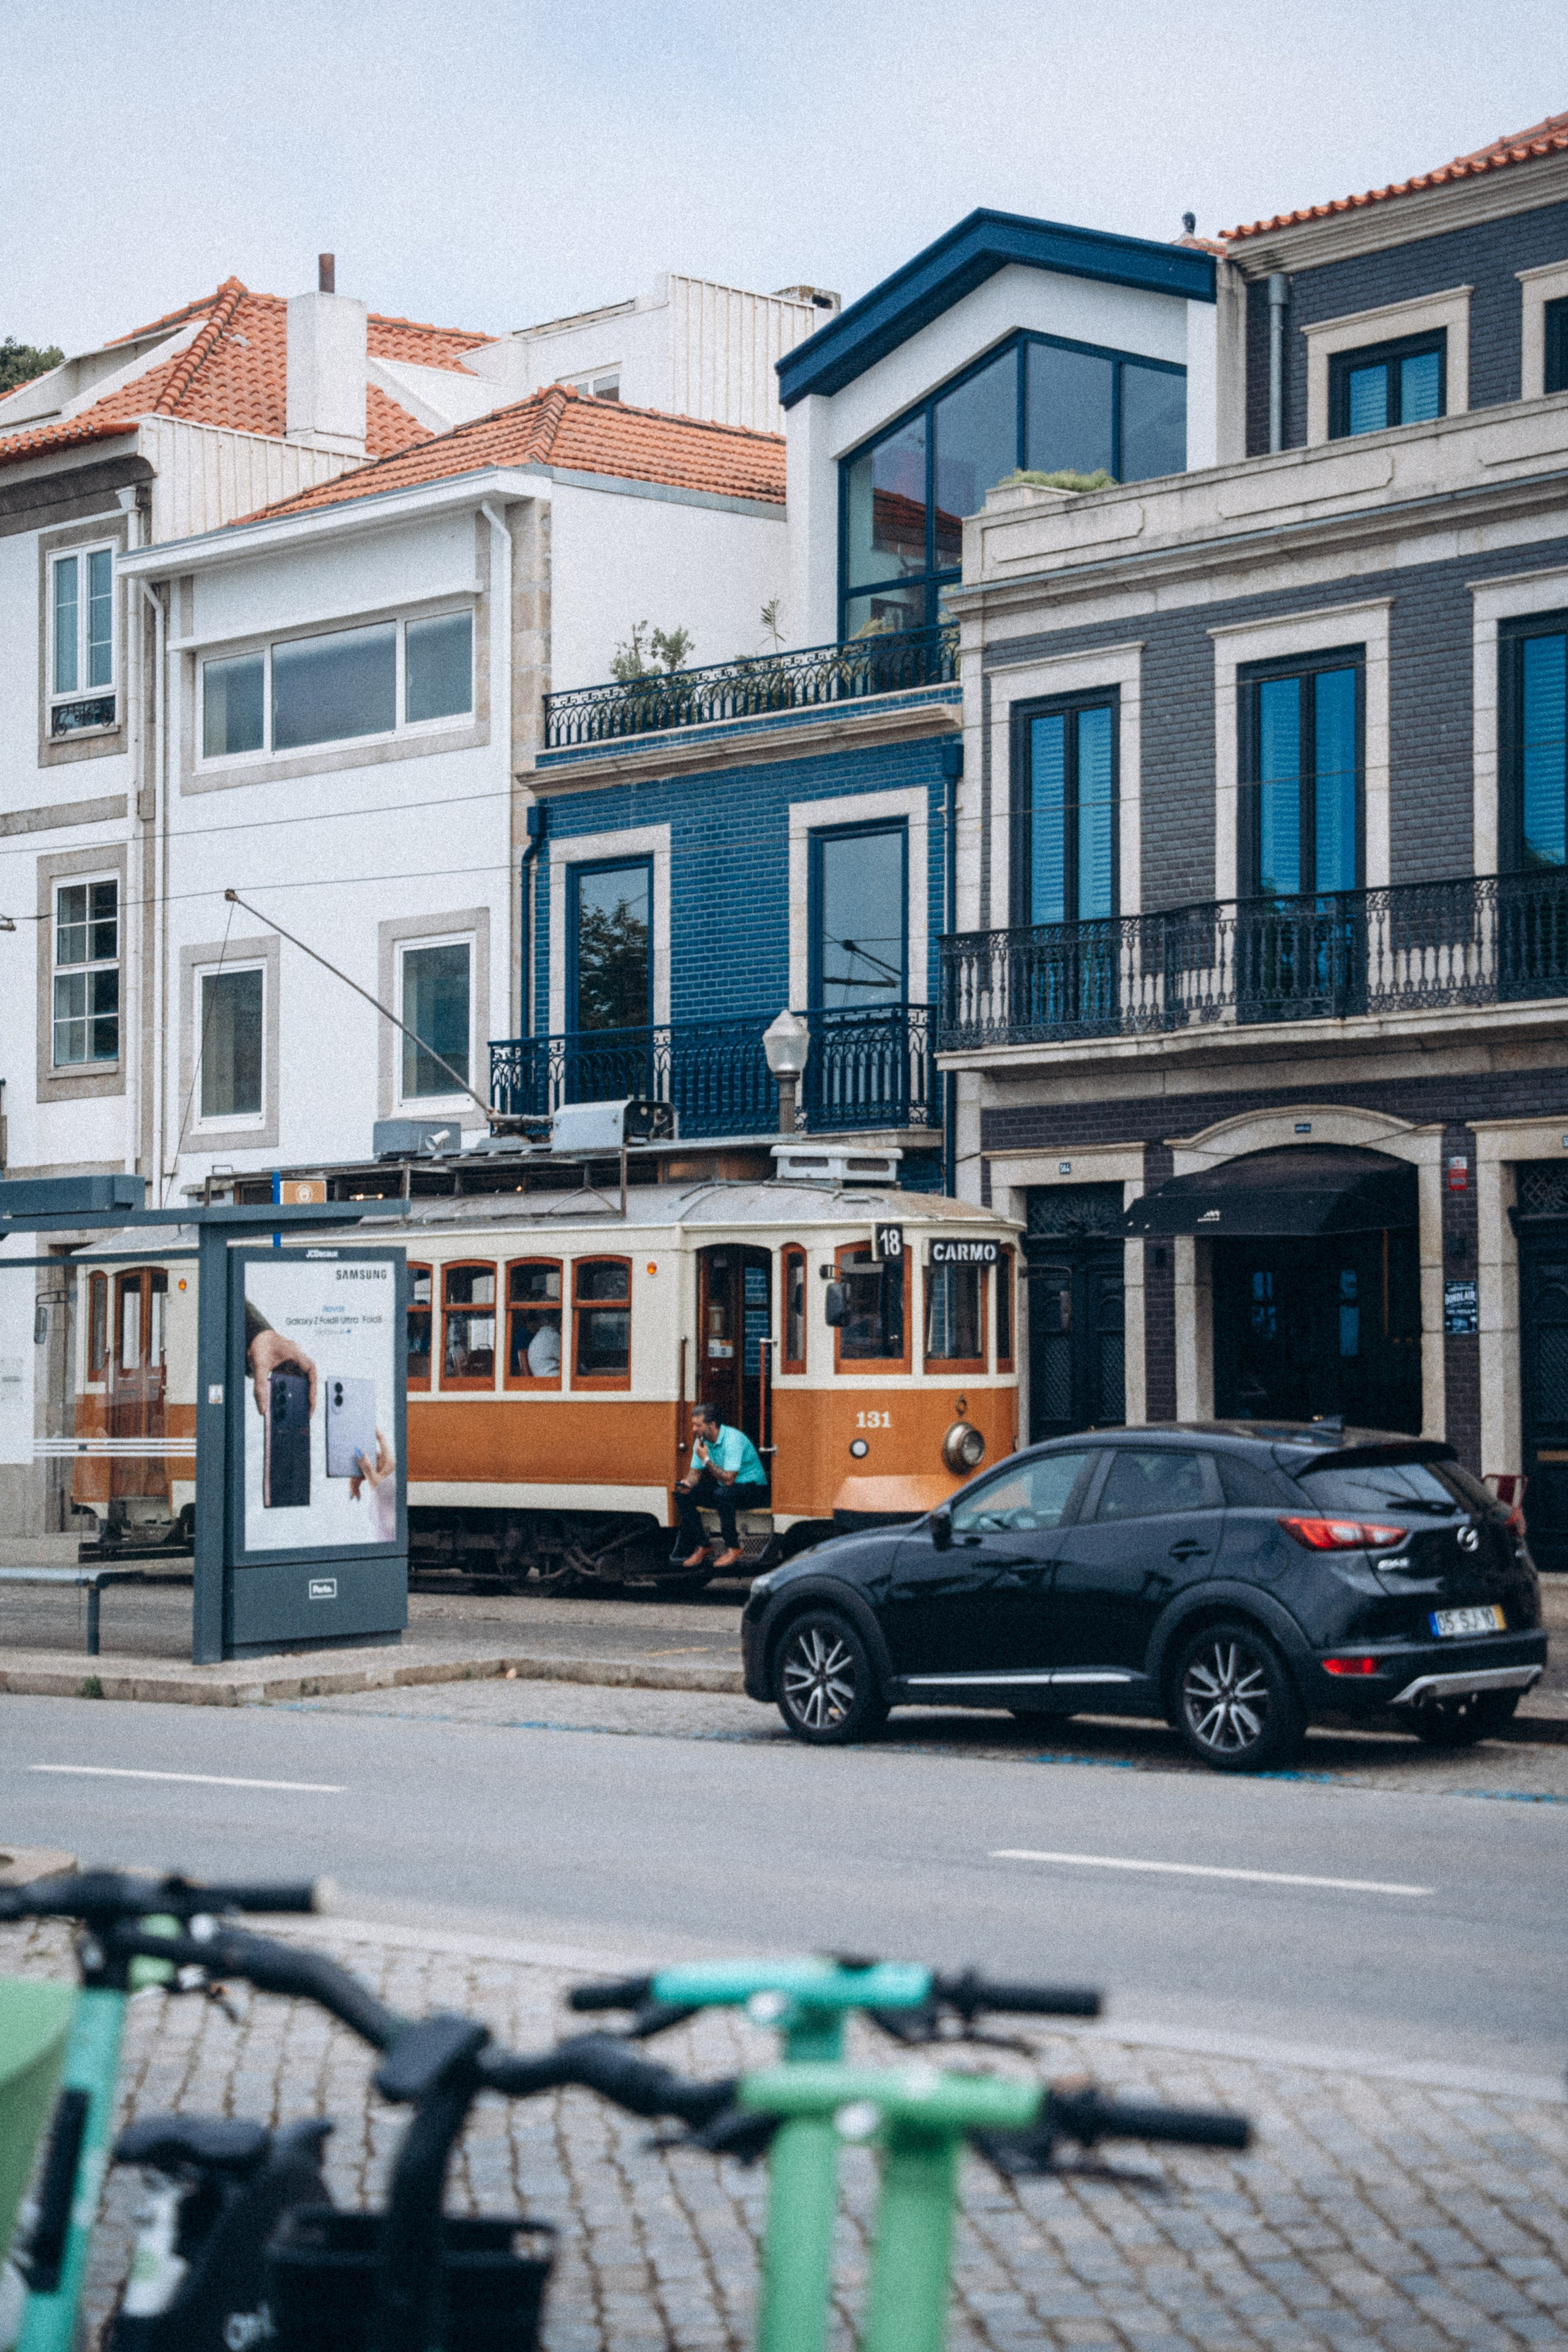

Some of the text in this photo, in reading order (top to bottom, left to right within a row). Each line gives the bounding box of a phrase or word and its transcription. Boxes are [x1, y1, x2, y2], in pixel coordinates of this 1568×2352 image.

[880, 1229, 901, 1256] 18
[933, 1243, 997, 1261] CARMO
[336, 1269, 387, 1280] SAMSUNG
[285, 1317, 312, 1326] Galaxy
[341, 1316, 359, 1324] Ultra
[856, 1411, 892, 1428] 131
